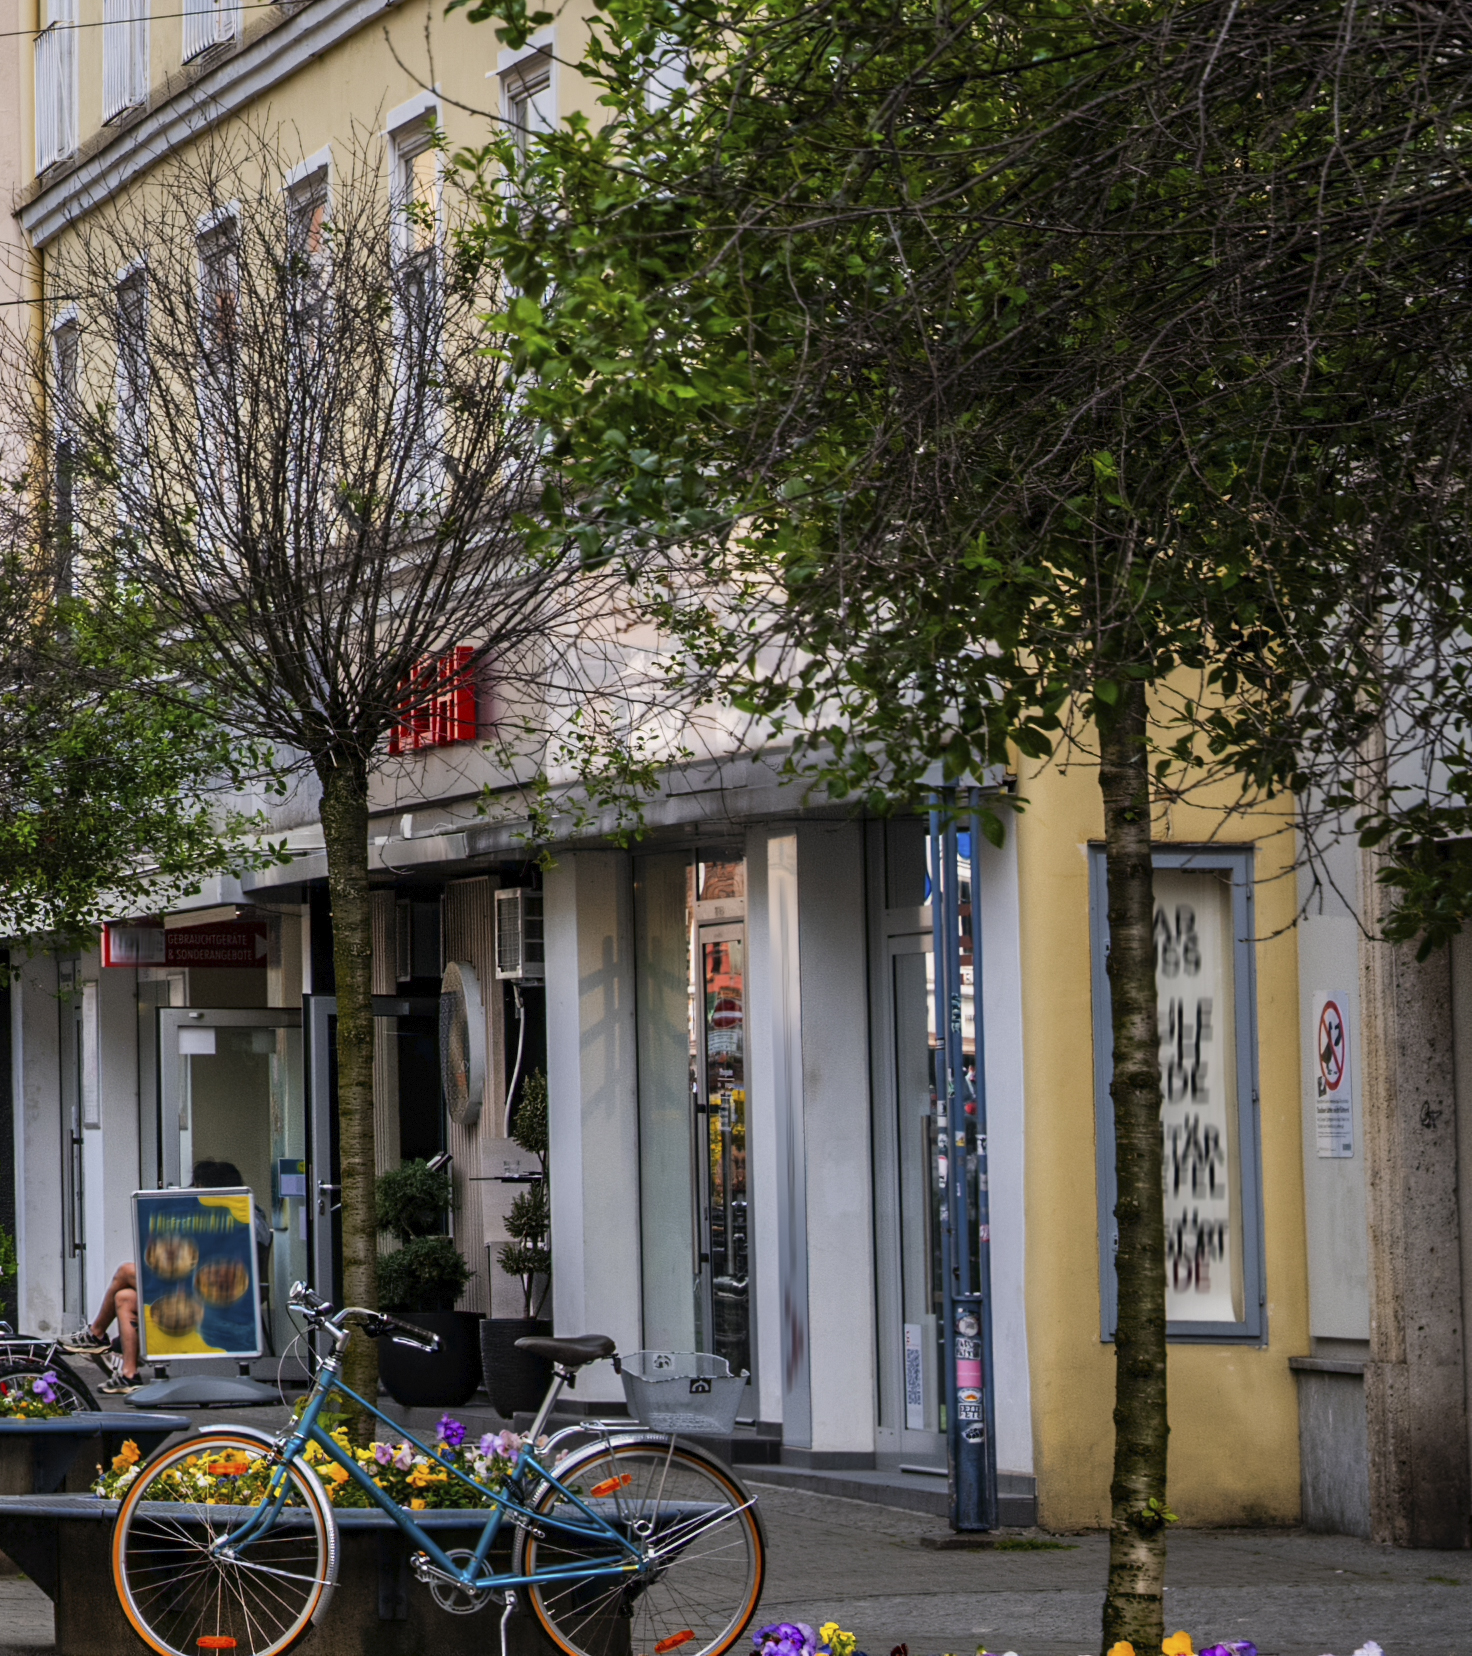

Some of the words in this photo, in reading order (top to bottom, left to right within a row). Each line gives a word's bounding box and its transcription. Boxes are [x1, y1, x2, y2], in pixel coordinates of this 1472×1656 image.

[167, 932, 247, 944] GEBRAUCHTGERÄTE
[168, 950, 174, 960] &
[176, 950, 253, 960] SONDERANGEBOTE
